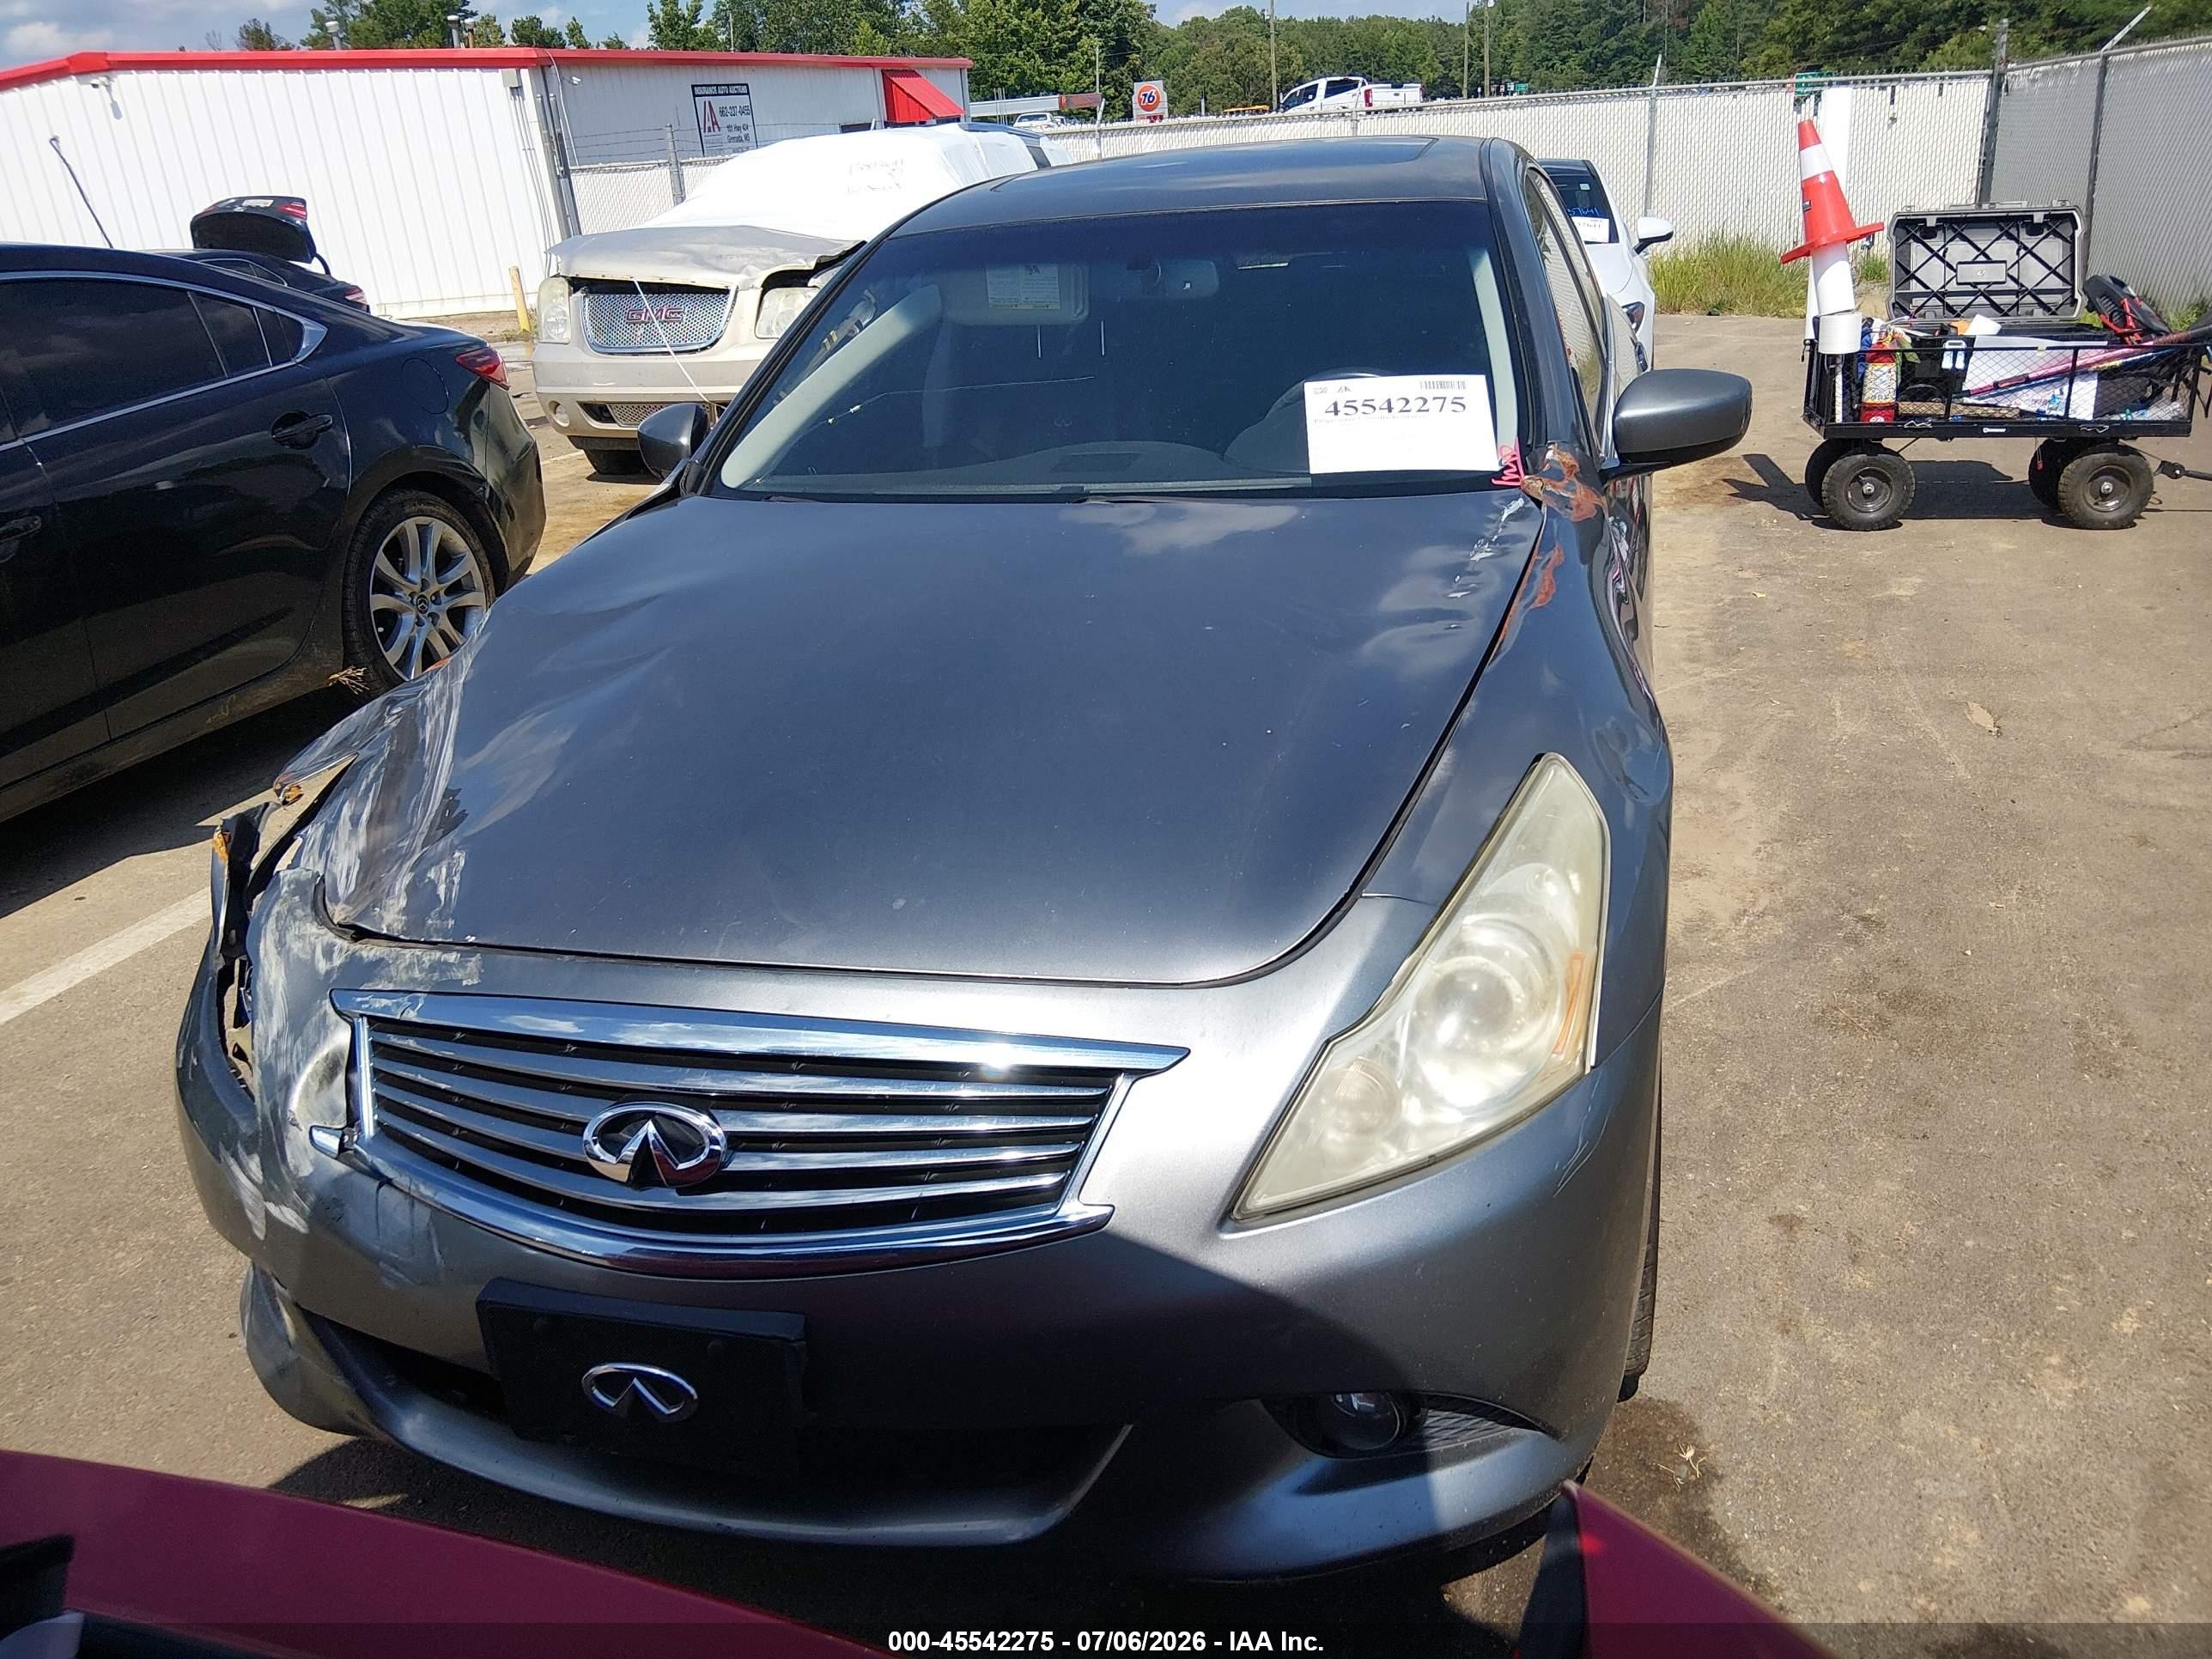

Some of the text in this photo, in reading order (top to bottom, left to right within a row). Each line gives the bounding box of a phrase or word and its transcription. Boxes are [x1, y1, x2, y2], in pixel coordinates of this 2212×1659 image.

[1140, 89, 1157, 106] 76
[626, 306, 685, 323] GMC
[1325, 396, 1467, 416] 45542275
